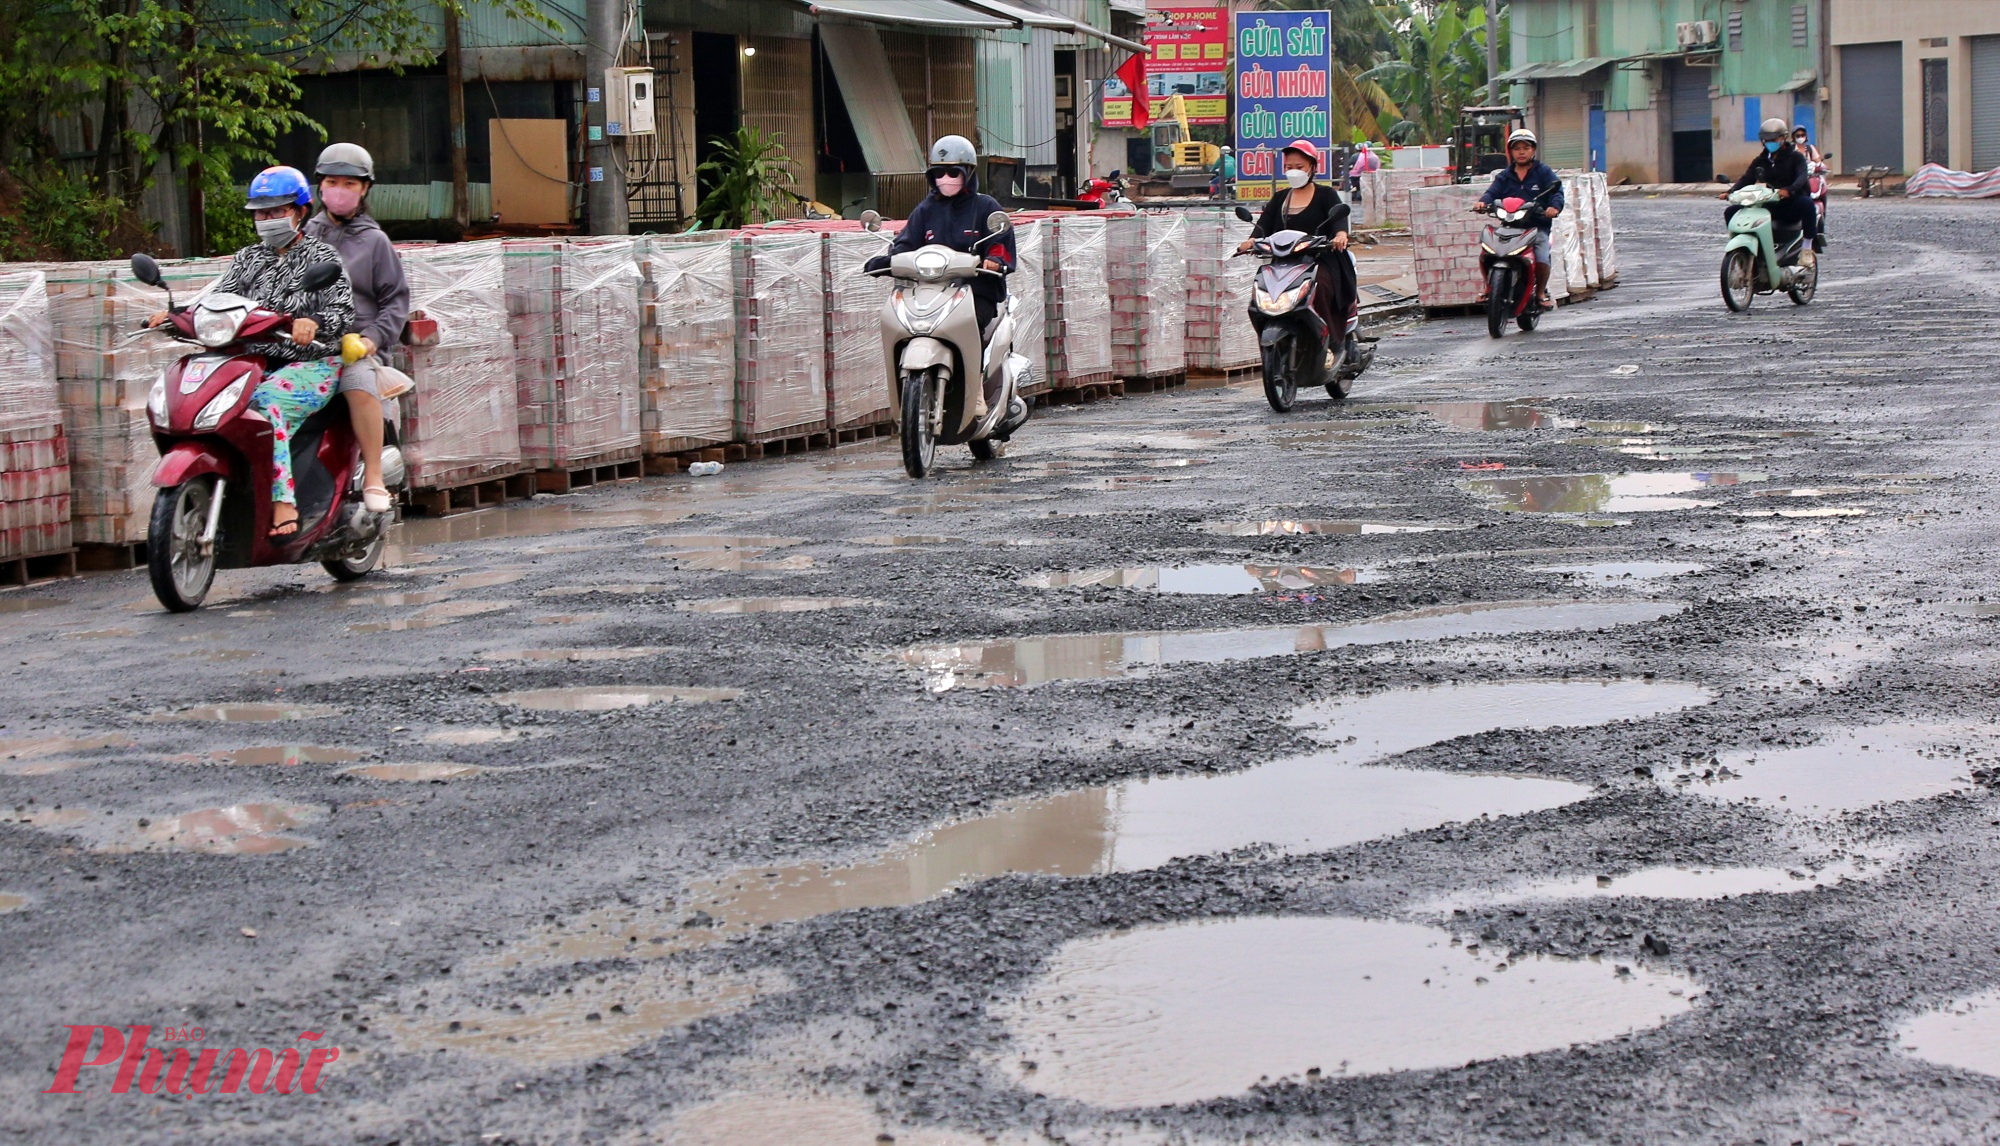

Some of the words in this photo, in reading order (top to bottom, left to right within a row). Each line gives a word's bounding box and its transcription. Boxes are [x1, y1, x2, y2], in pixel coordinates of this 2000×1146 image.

[1186, 12, 1217, 20] P-HOME
[1241, 18, 1283, 57] CỬA
[1287, 16, 1326, 56] SẮT
[1240, 62, 1274, 98] CỬA
[1277, 63, 1326, 98] NHÔM
[1241, 104, 1277, 139] CỬA
[1280, 105, 1327, 138] CUỐN
[1253, 187, 1271, 198] 0936
